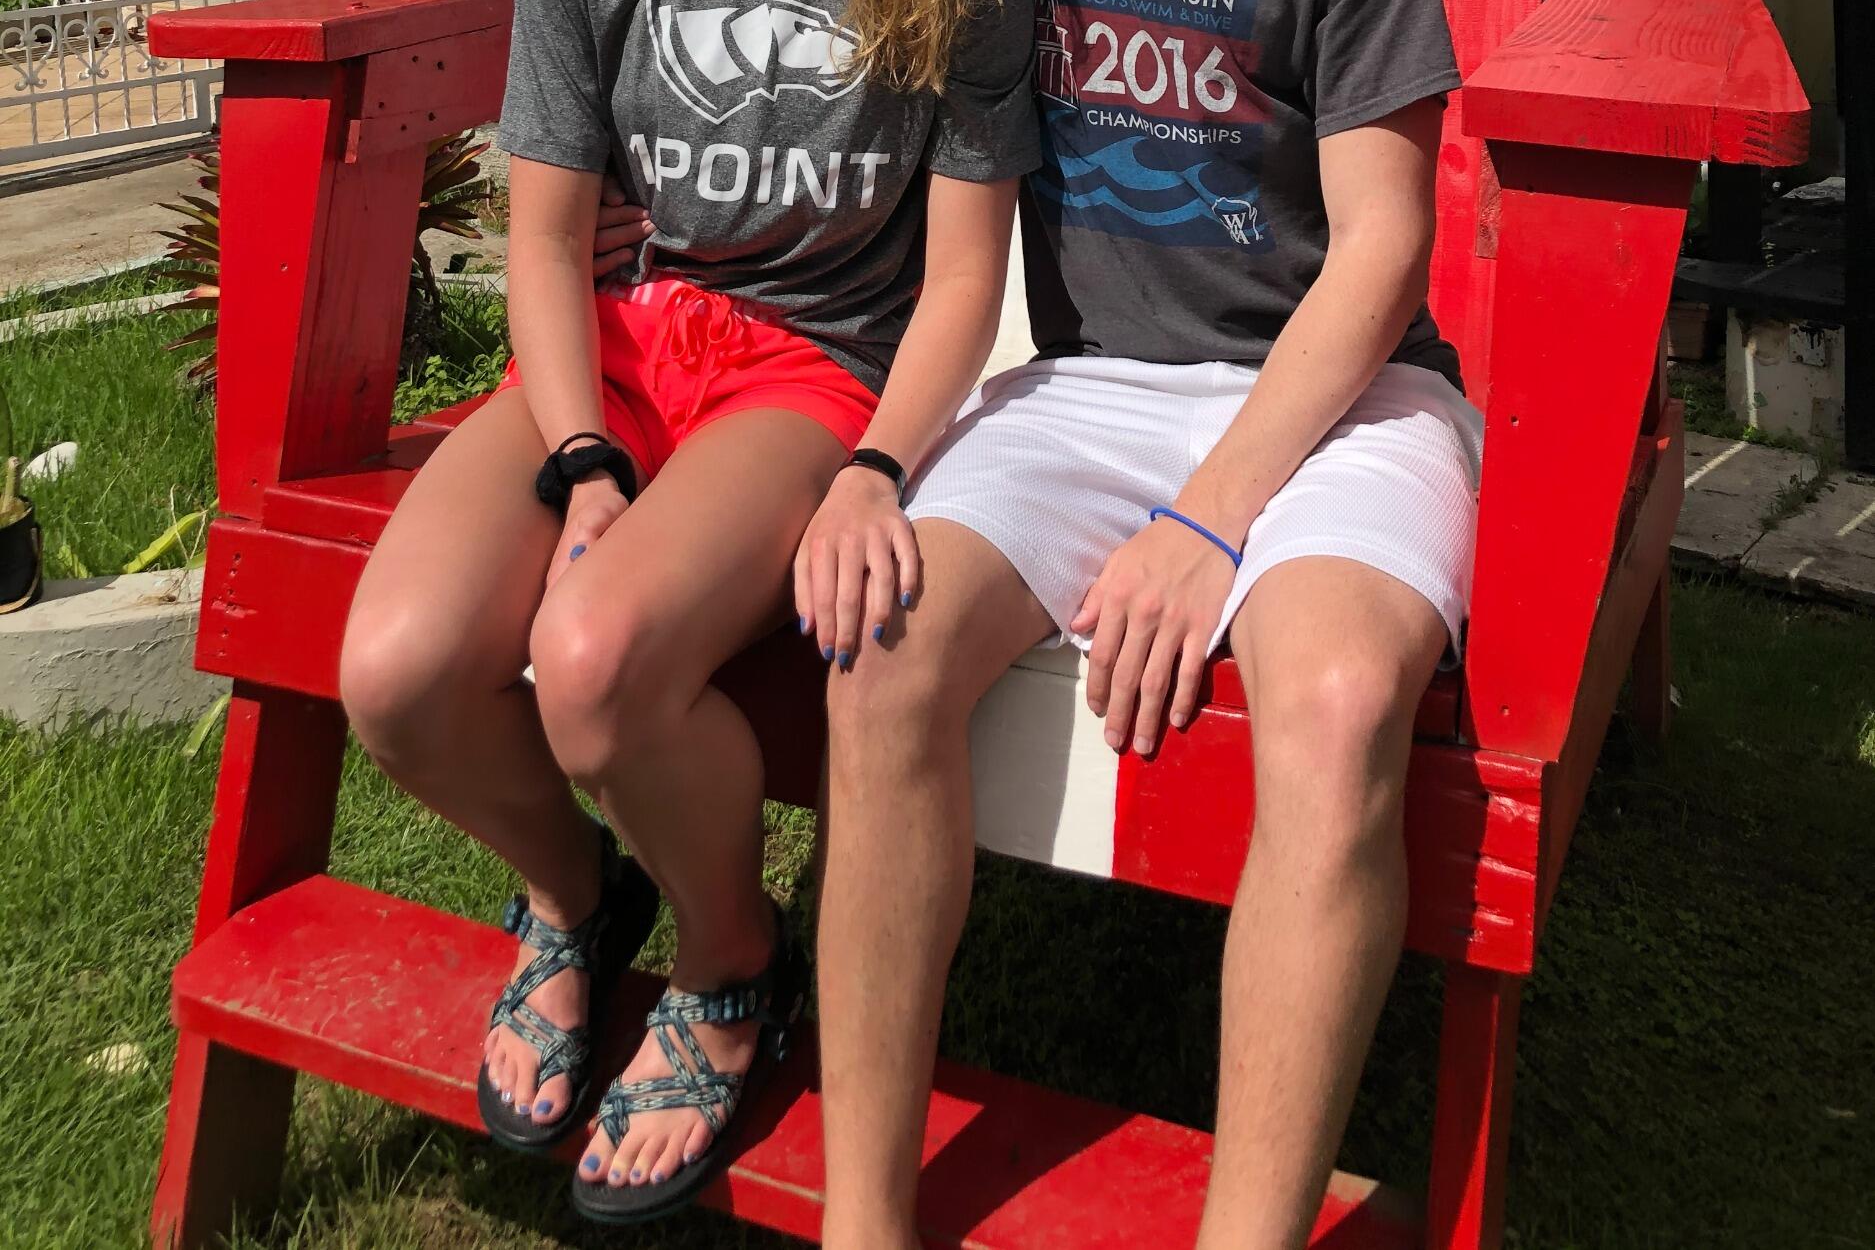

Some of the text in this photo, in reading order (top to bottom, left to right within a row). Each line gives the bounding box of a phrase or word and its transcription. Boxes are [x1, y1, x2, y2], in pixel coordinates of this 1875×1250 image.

[1194, 11, 1233, 30] DIVE
[1081, 21, 1238, 113] 2016
[1086, 110, 1242, 145] CHAMPIONSHIPS
